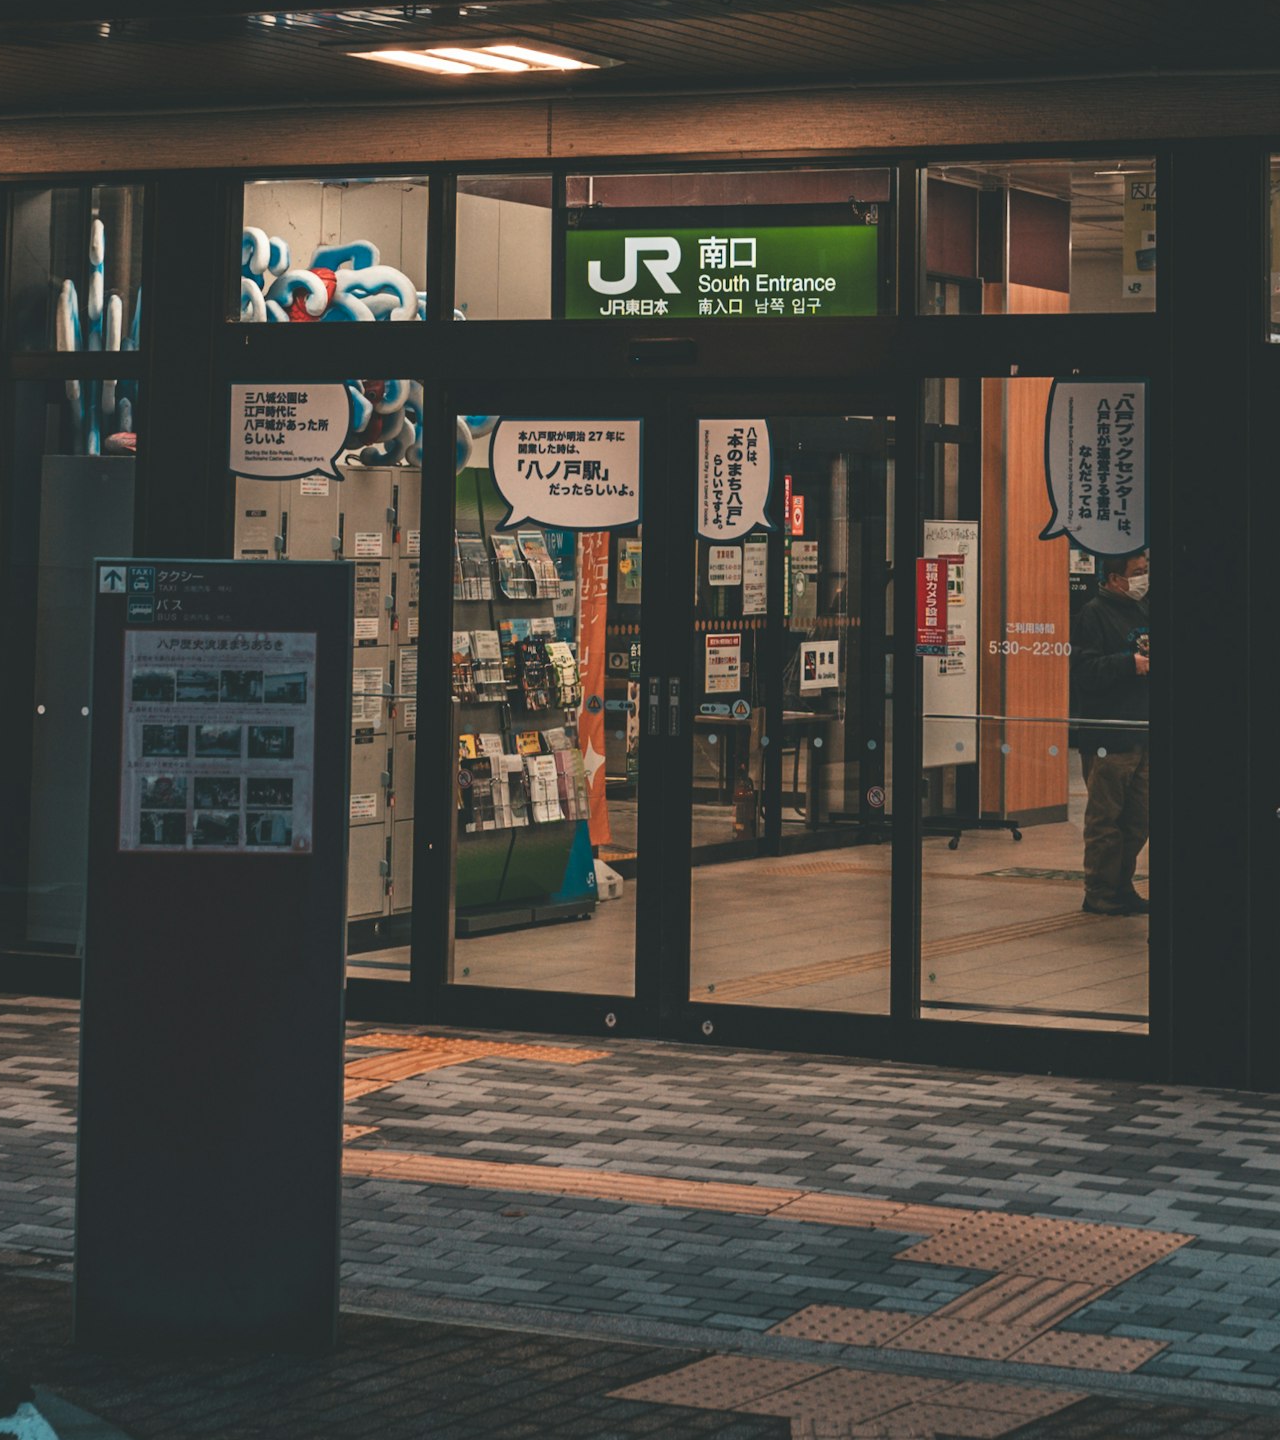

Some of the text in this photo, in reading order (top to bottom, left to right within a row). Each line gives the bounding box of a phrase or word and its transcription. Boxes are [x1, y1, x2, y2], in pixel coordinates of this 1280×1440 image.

[698, 236, 757, 269] 南口
[587, 236, 682, 295] JR
[698, 274, 836, 292] South Entrance
[599, 299, 668, 316] JR東日本
[698, 297, 822, 314] 南入口 남쪽 입구
[244, 392, 308, 404] 三八城公園は
[244, 406, 296, 418] 江戸時代に
[244, 419, 328, 431] 八戸城があった所
[244, 432, 285, 444] らしいよ
[518, 431, 625, 442] 本八戸駅が明治 27 年に
[518, 444, 580, 454] 開業した時は、
[747, 427, 757, 466] 八戸は、
[1097, 398, 1111, 521] 八戸市が運営する書店
[1079, 445, 1092, 519] なんだってね
[549, 483, 634, 496] だったらしいよ。
[712, 454, 723, 529] らしいですよ。
[157, 570, 204, 582] タクシー
[159, 584, 177, 592] TAXI
[925, 562, 939, 626] 監視カメラ設置
[156, 598, 183, 611] バス
[157, 613, 177, 621] BUS
[1006, 623, 1055, 635] ご利用時間
